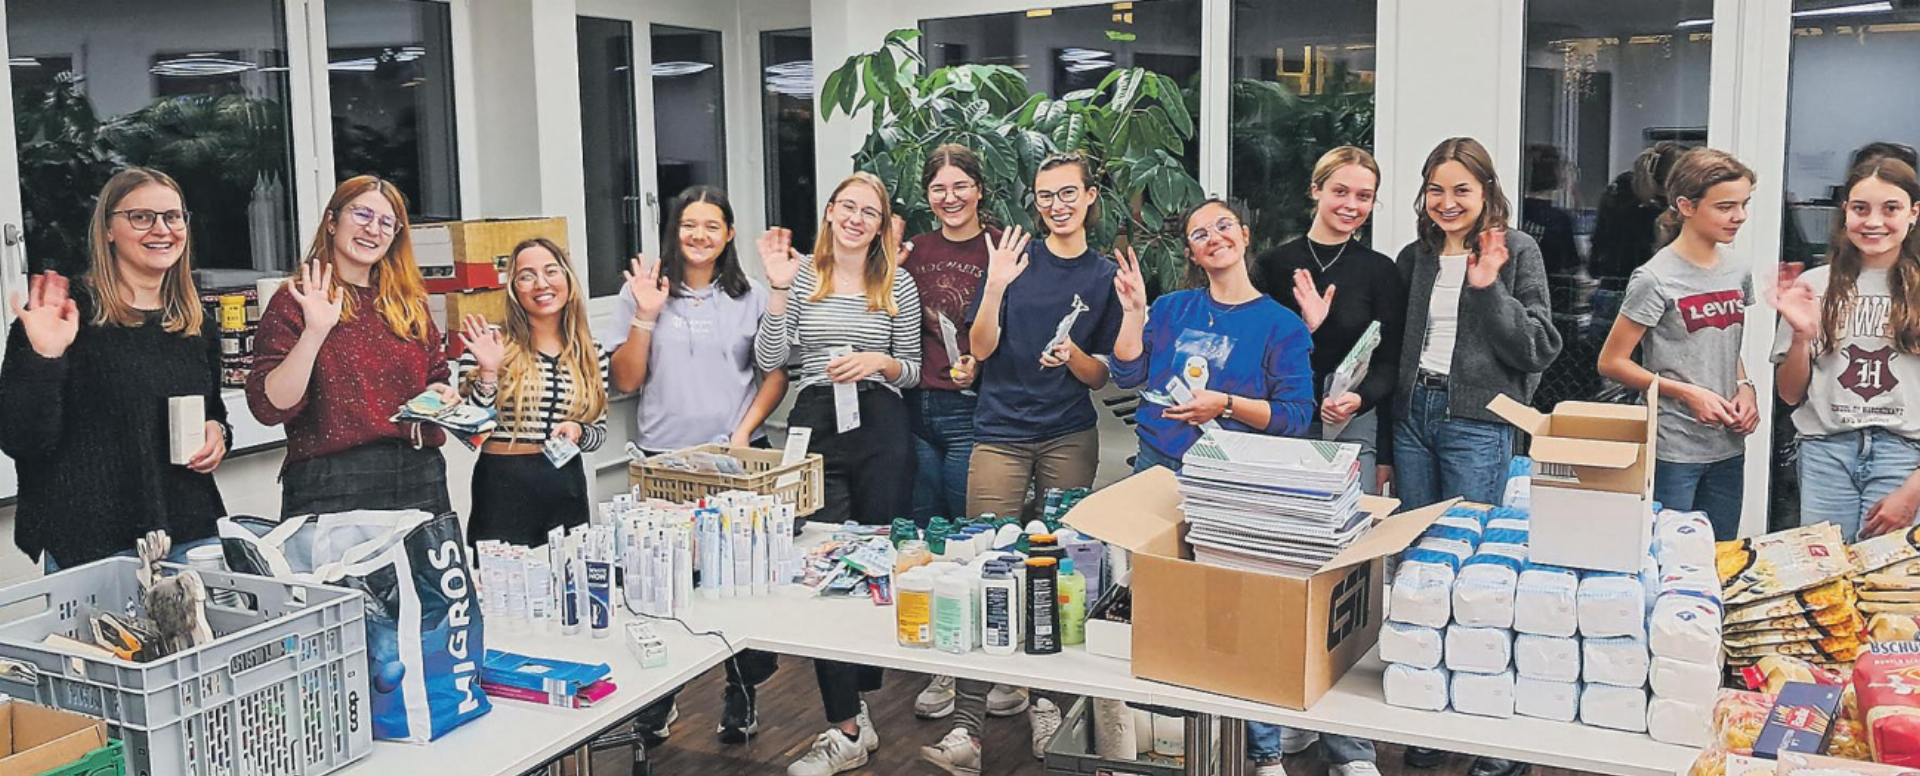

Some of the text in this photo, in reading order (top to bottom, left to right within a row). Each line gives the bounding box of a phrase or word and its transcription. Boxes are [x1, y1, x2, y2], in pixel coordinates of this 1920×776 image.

[428, 540, 478, 714] MIGROS
[1871, 641, 1920, 654] BSCHU
[349, 690, 360, 732] coop
